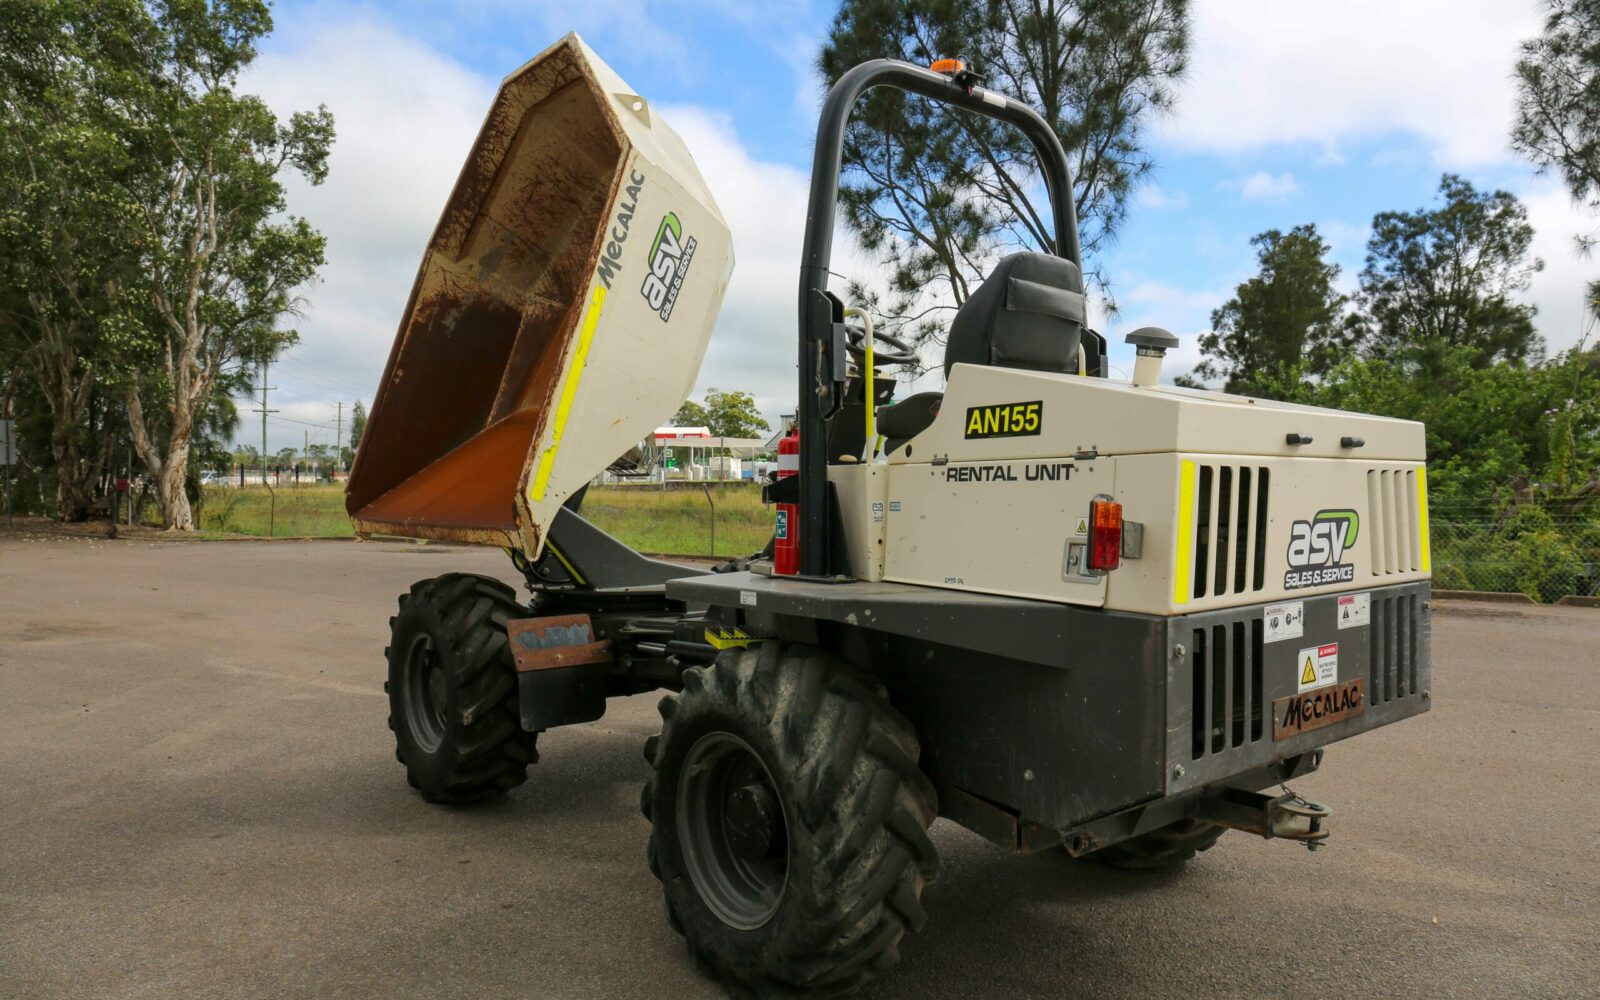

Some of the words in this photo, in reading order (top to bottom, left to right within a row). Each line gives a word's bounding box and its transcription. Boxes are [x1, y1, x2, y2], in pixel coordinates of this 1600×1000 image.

[677, 238, 697, 278] SERVICE
[966, 404, 1039, 435] AN155
[946, 465, 1018, 482] RENTAL
[1025, 463, 1075, 481] UNIT
[1312, 569, 1321, 583] &
[1321, 566, 1353, 581] SERVICE
